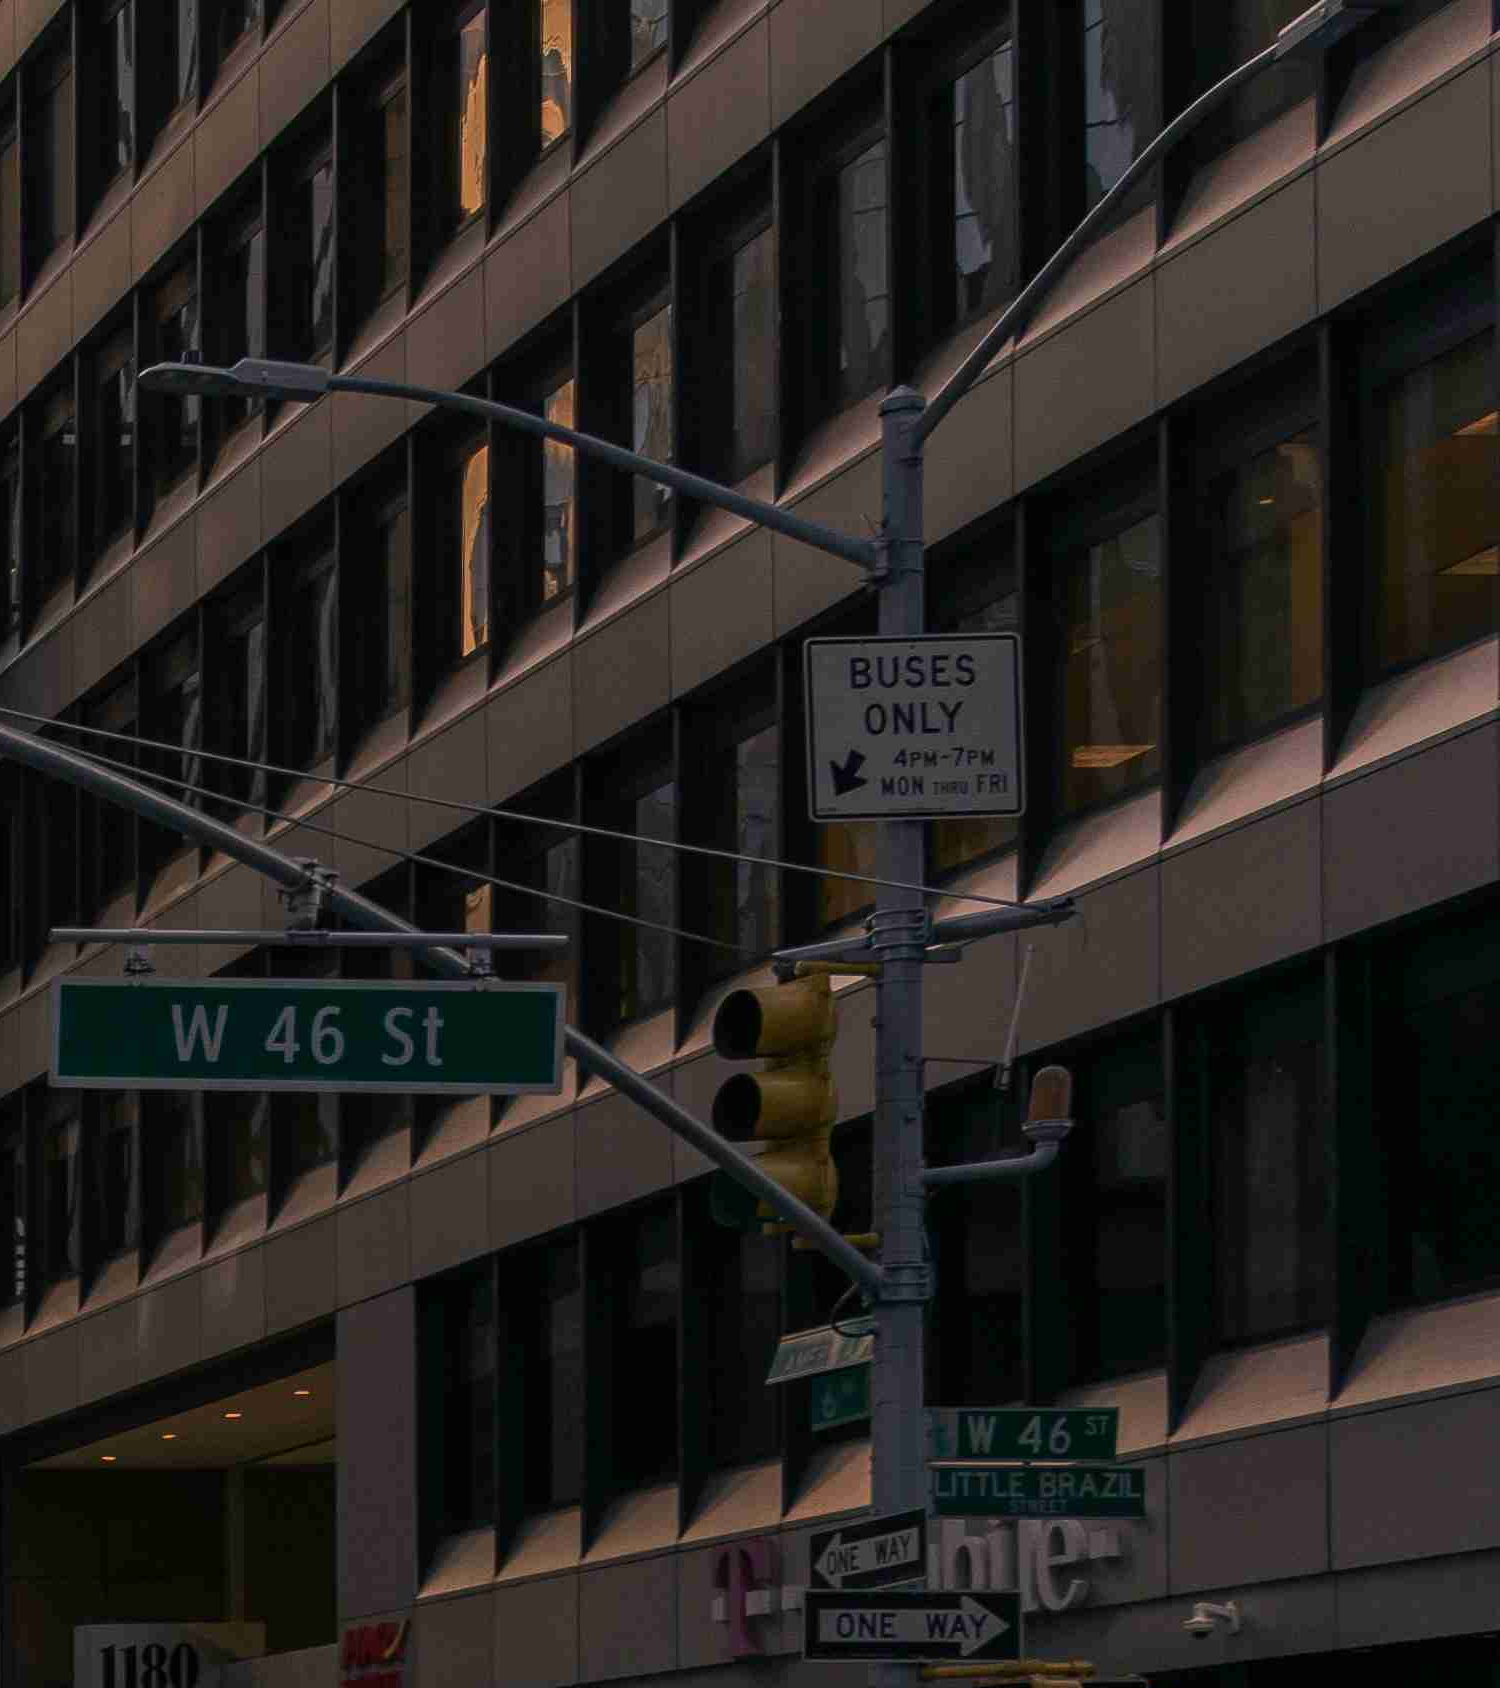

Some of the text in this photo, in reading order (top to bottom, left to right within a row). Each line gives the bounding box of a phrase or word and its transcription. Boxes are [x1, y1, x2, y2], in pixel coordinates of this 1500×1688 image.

[850, 654, 975, 689] BUSES
[865, 701, 963, 735] ONLY
[893, 747, 995, 768] 4PM-7PM
[881, 776, 924, 796] MON
[975, 774, 1008, 793] FRI
[171, 1004, 445, 1067] W 46 St
[968, 1415, 1110, 1455] W 46 ST
[935, 1469, 1141, 1498] LITTLE BRAZIL
[1008, 1499, 1069, 1513] STREET
[826, 1529, 912, 1576] ONE WAY
[836, 1612, 989, 1639] ONE WAY
